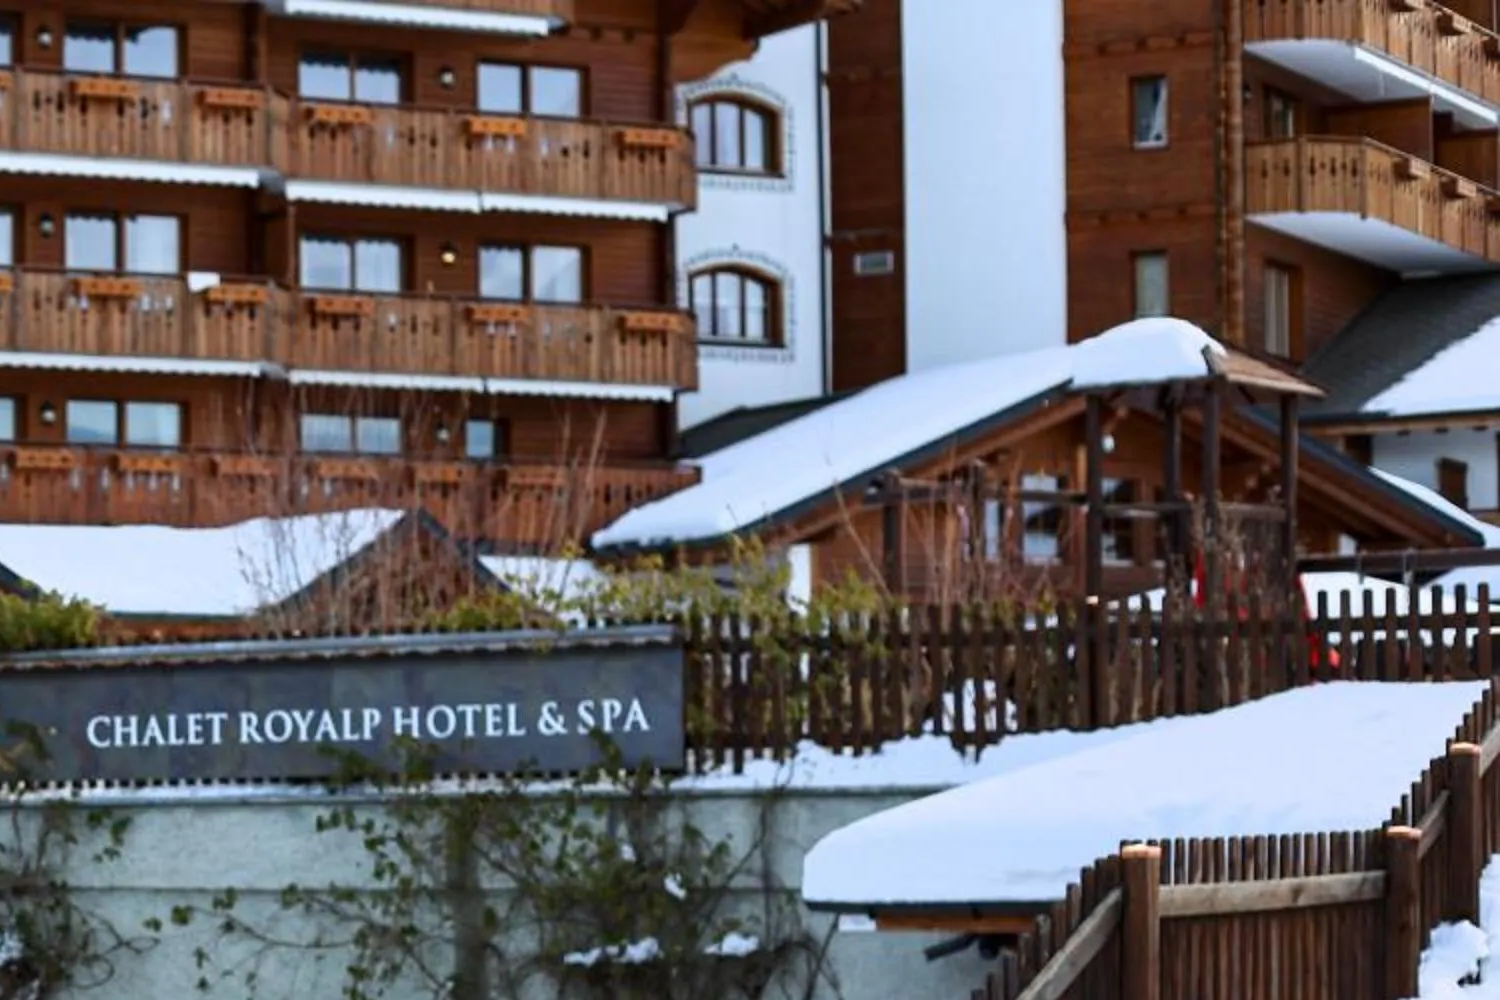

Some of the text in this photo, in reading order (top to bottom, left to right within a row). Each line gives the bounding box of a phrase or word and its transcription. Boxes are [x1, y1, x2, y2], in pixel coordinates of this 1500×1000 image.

[86, 698, 650, 749] CHALET ROYALP HOTEL & SPA
